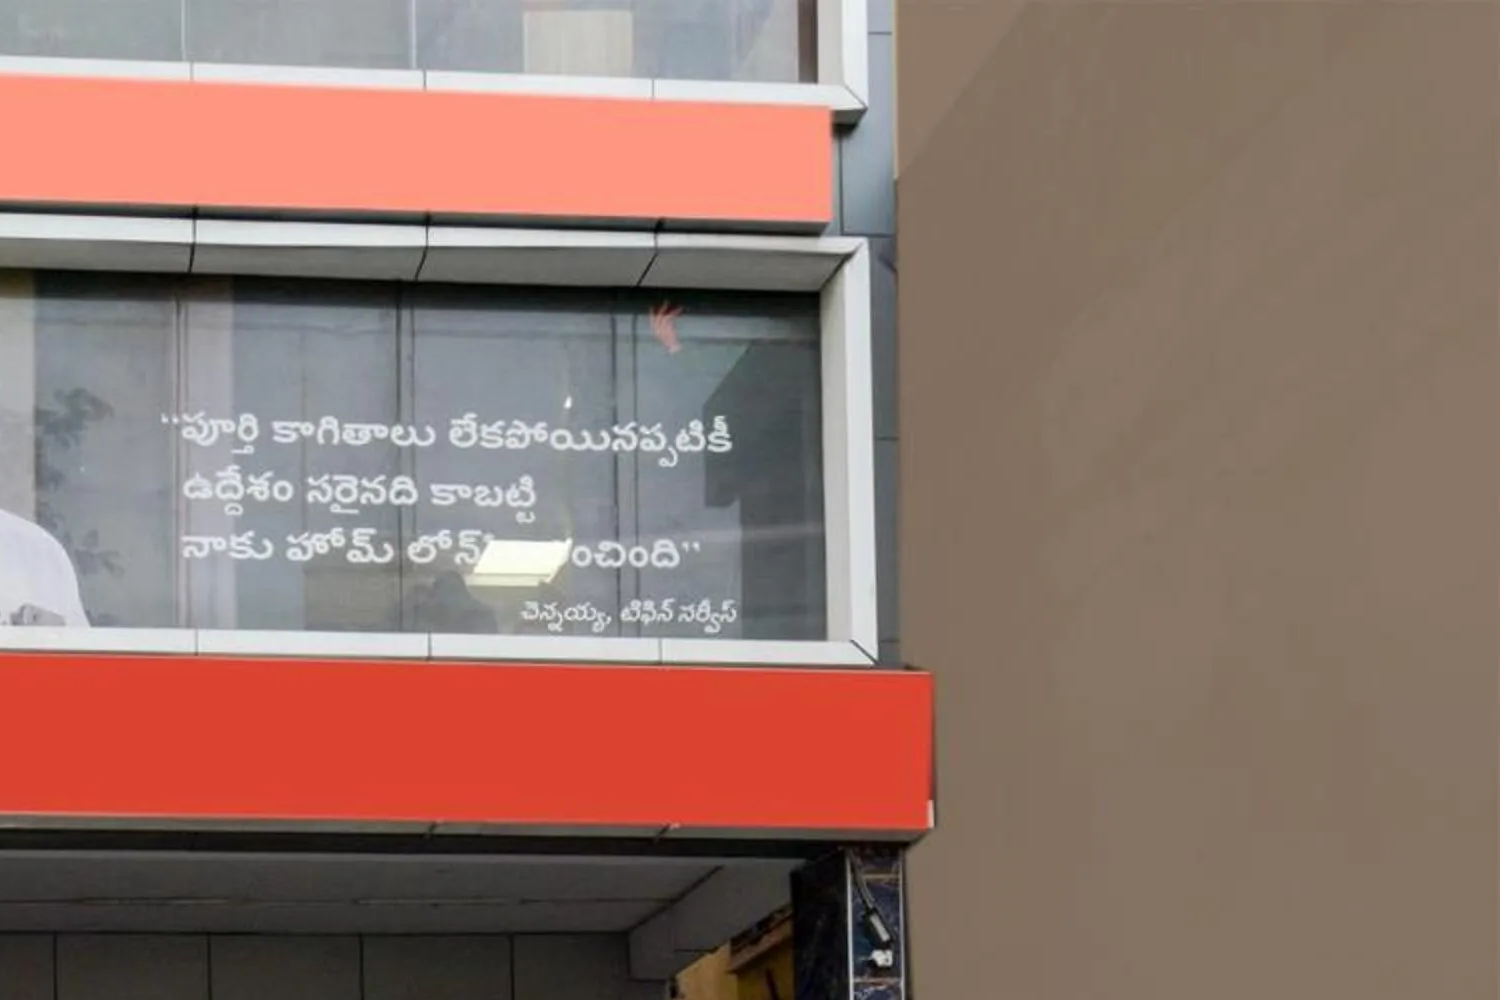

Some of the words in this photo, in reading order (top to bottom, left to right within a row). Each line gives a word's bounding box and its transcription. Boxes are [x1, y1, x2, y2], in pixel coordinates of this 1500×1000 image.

[272, 416, 436, 447] కాగితాలు
[449, 412, 733, 467] లేకపోయినప్పటికీ
[183, 464, 294, 516] ఉద్దేశం
[307, 473, 419, 515] సరైనది
[429, 474, 536, 524] కాబట్టి
[180, 530, 275, 560] నాకు
[286, 527, 395, 564] హోమ్
